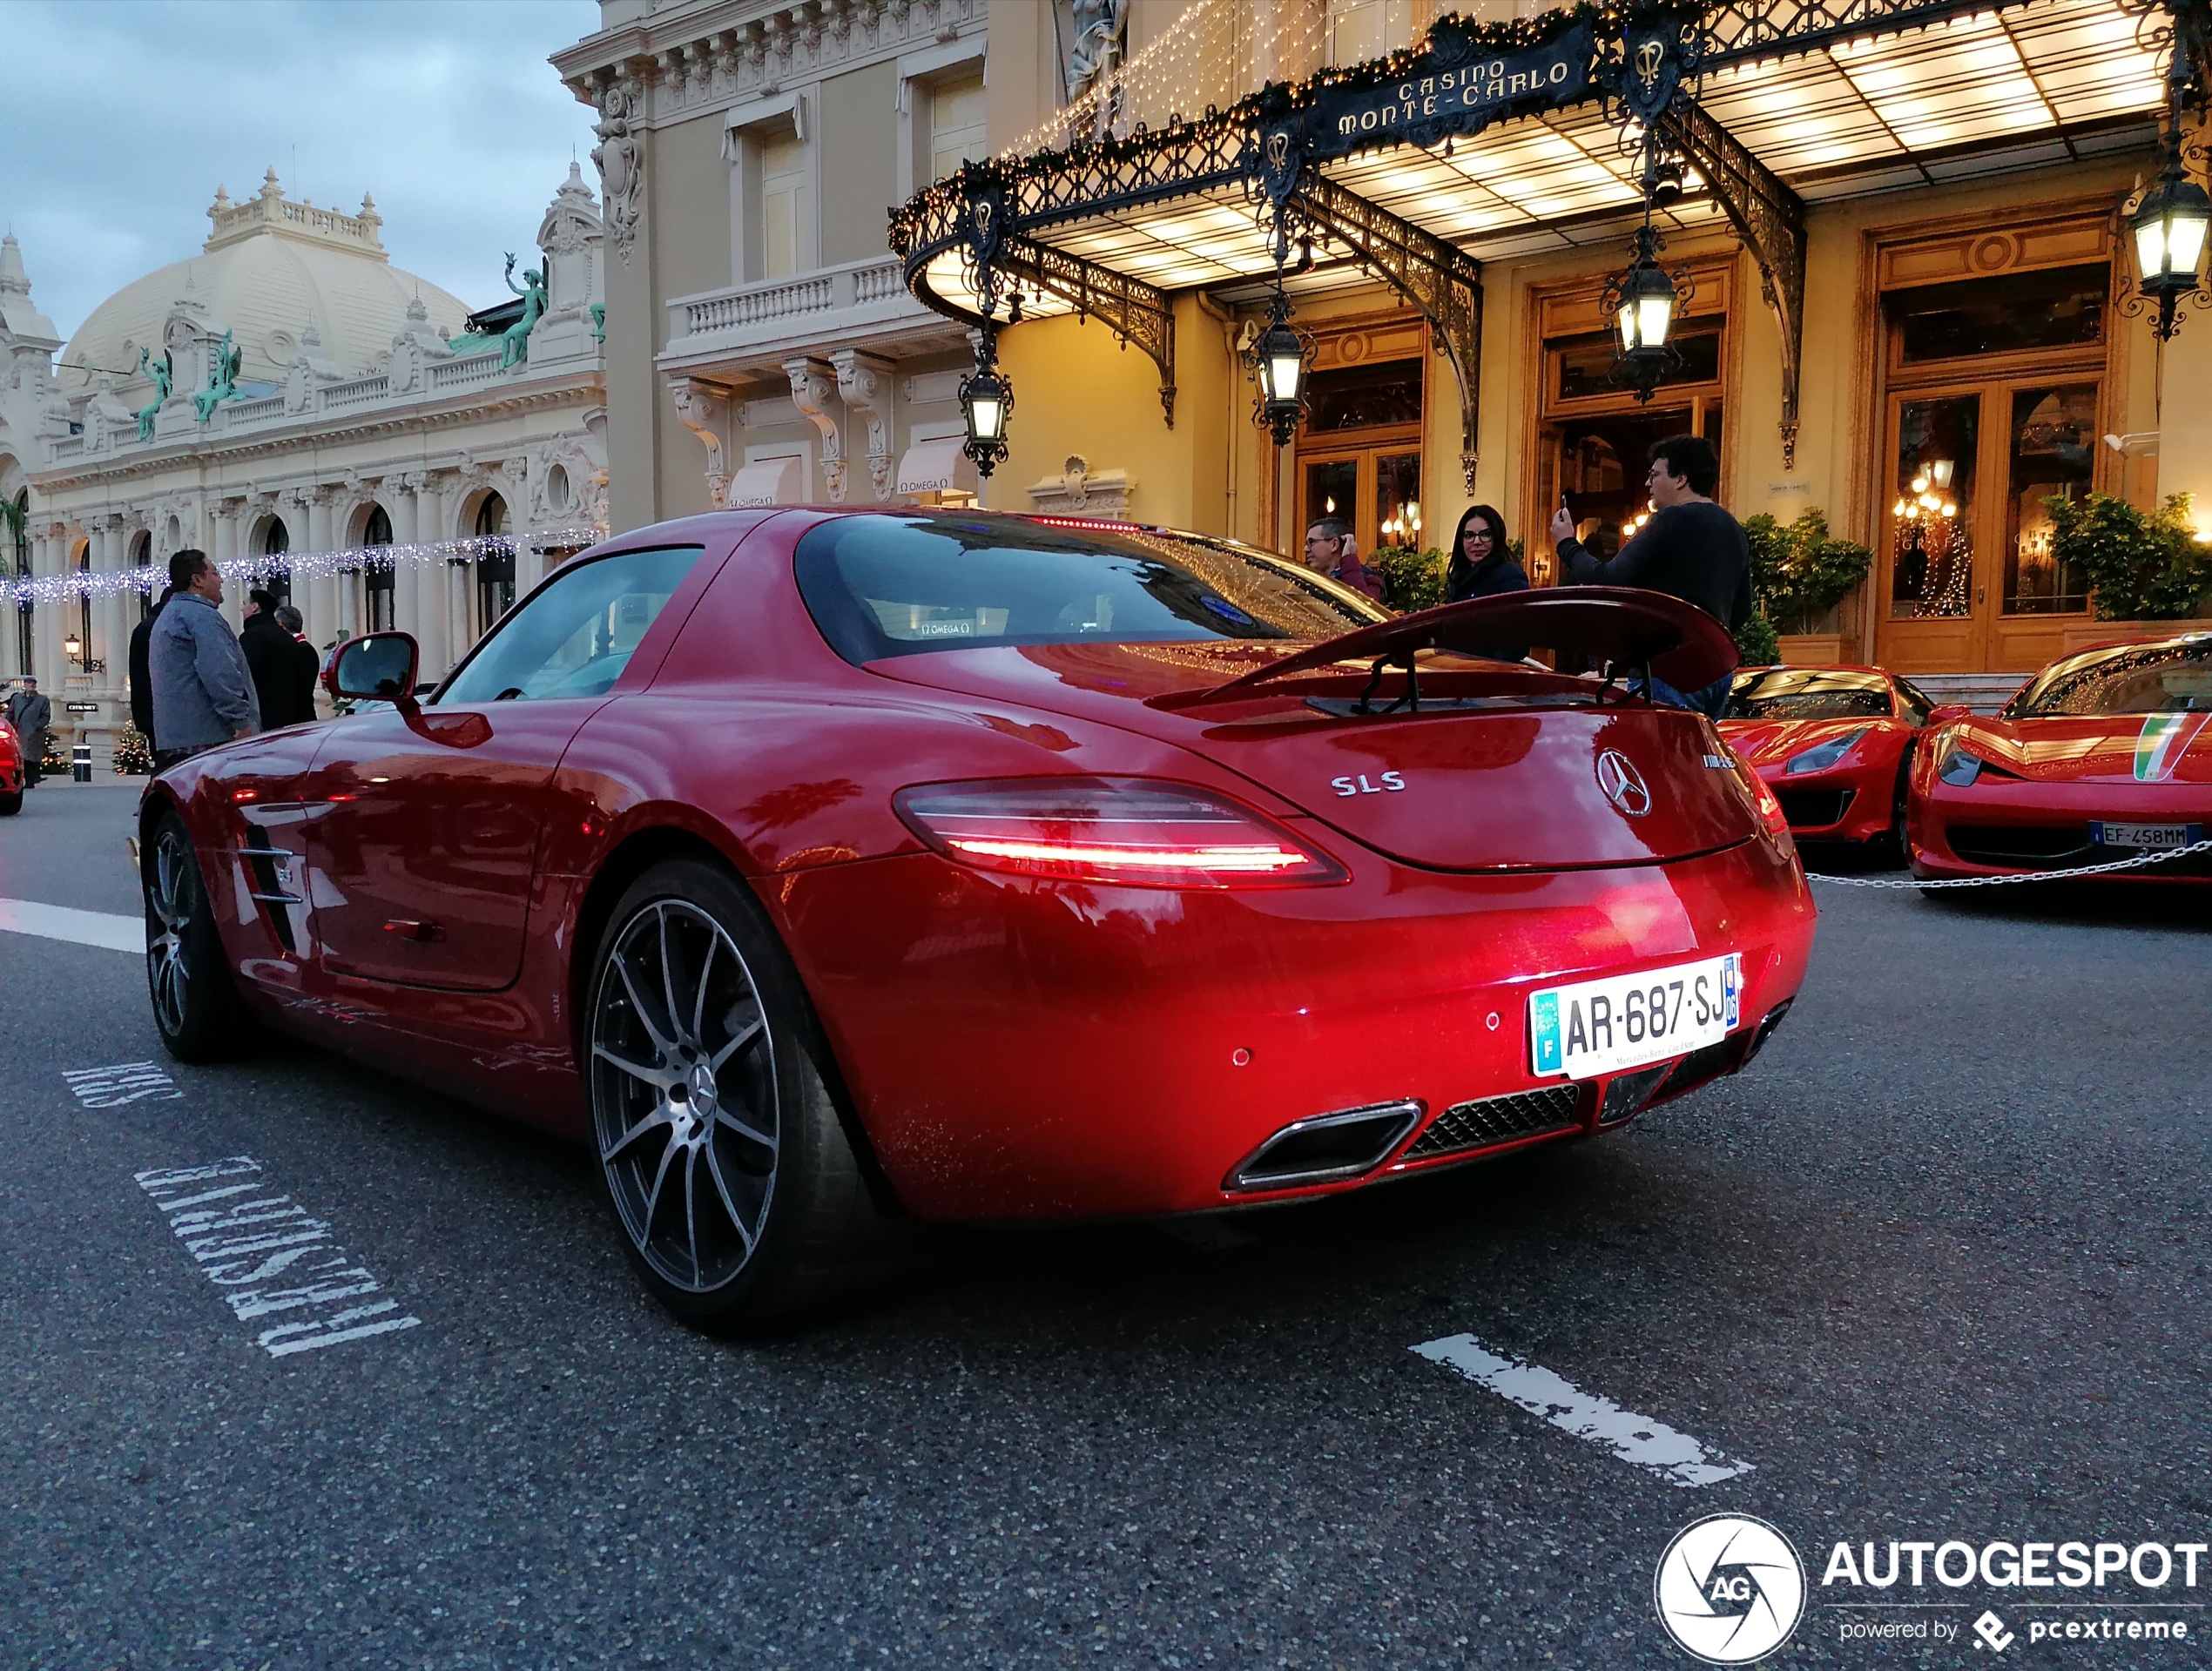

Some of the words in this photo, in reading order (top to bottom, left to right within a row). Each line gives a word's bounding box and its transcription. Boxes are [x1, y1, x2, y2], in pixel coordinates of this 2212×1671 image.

[1398, 60, 1506, 102] CASINO
[910, 480, 938, 491] OMEGA
[738, 497, 765, 508] OMEGA
[1902, 536, 1966, 550] GRAFF
[931, 624, 960, 634] OMEGA
[1331, 771, 1406, 797] SLS
[1725, 994, 1737, 1021] 06
[1543, 1040, 1554, 1059] F
[1615, 1048, 1665, 1065] Mercedes-Benz
